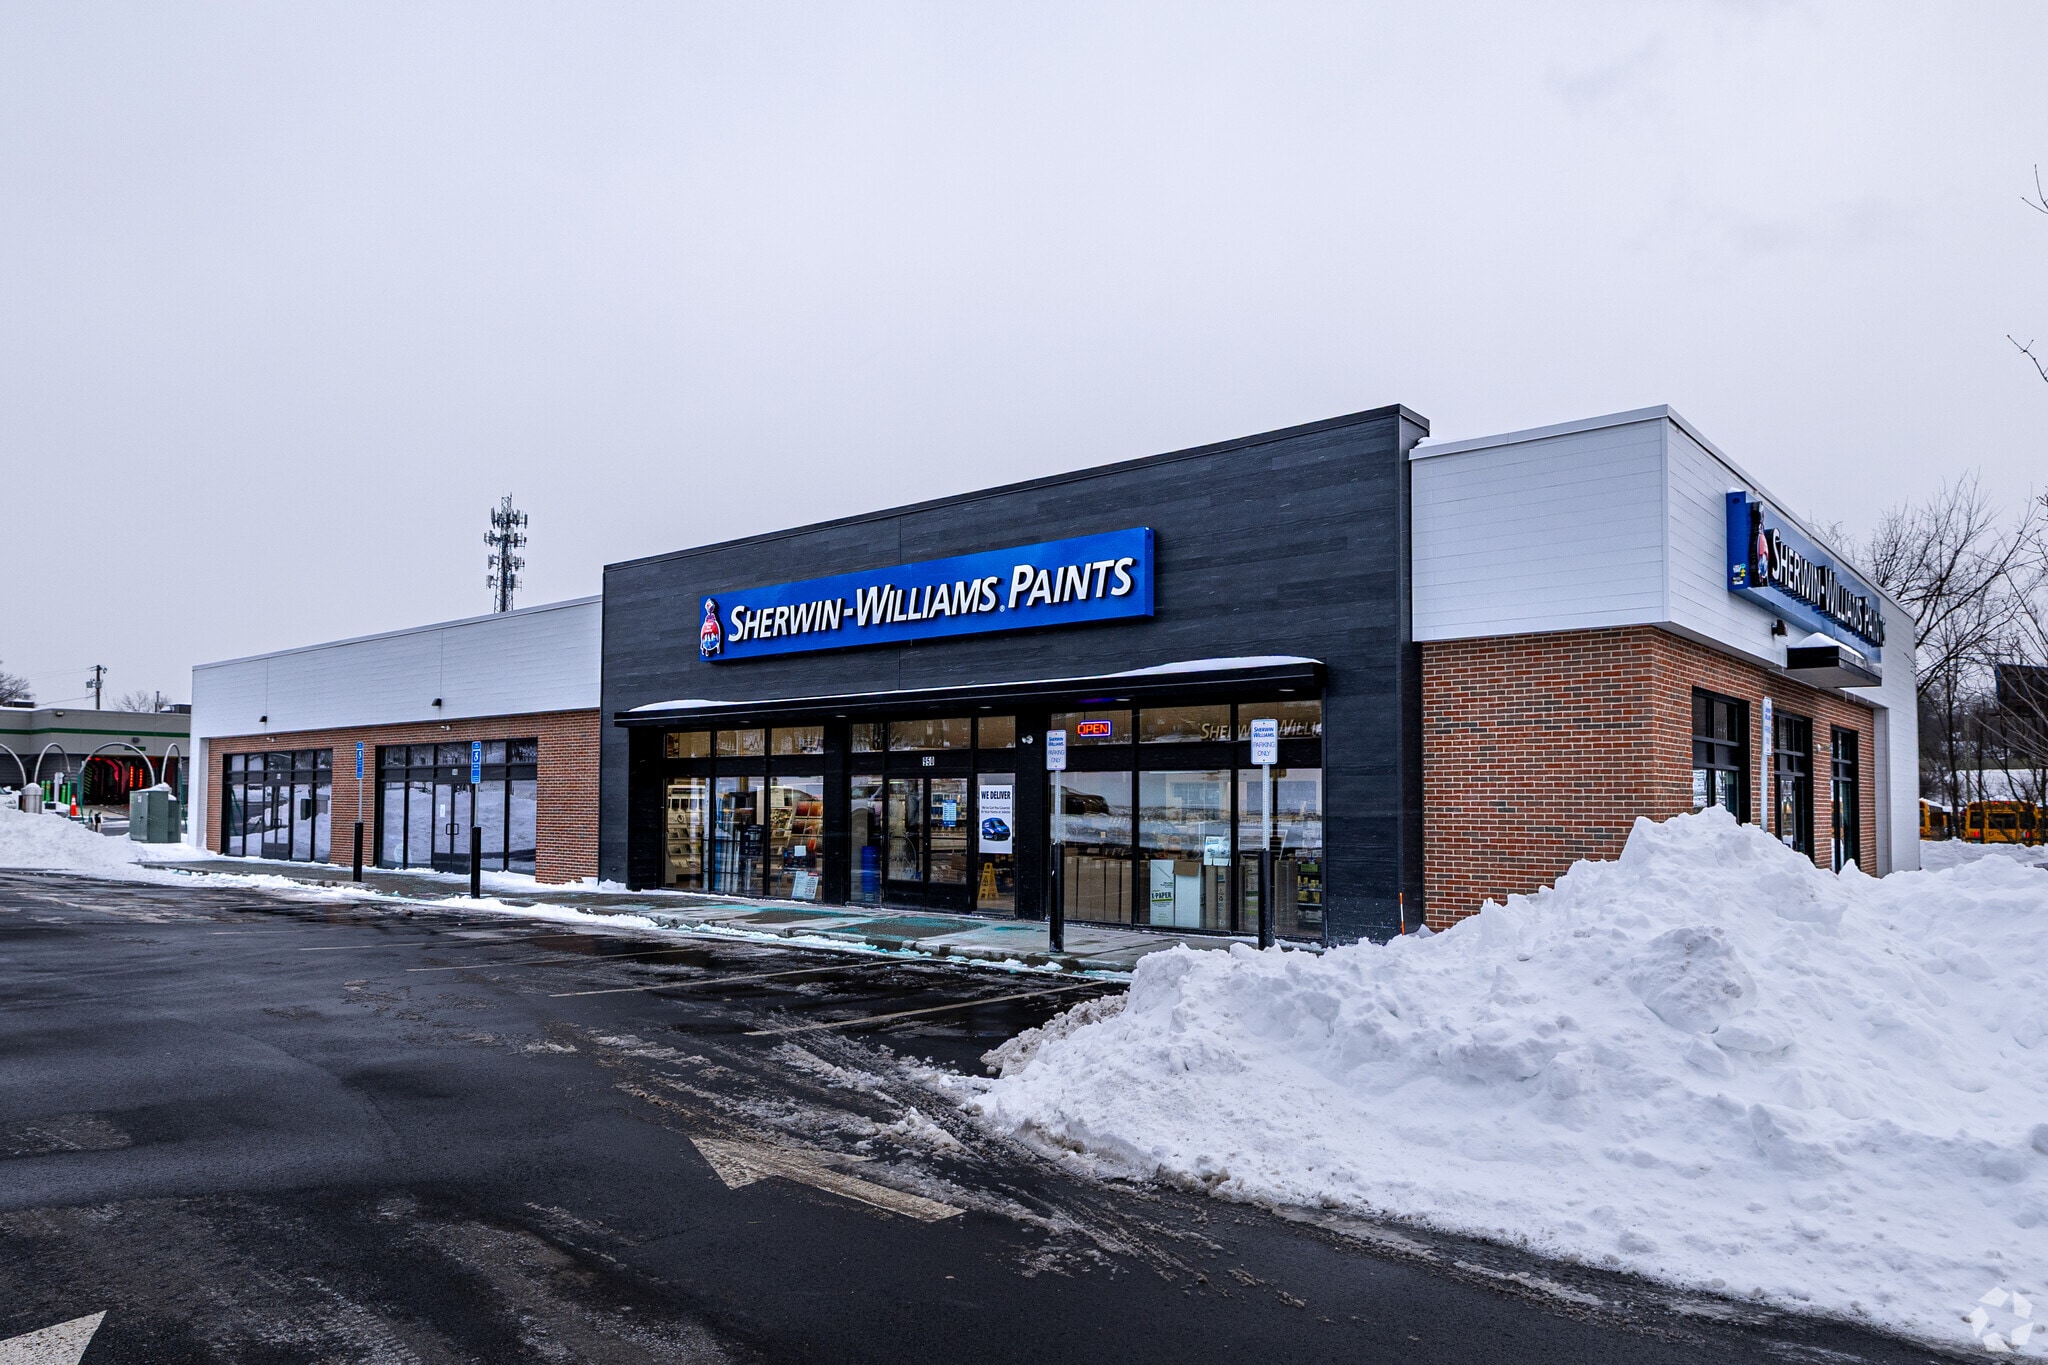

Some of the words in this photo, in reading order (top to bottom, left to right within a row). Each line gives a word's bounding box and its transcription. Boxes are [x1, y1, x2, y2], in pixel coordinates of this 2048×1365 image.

[1008, 557, 1135, 609] PAINTS
[1077, 723, 1108, 735] OPEN
[981, 791, 989, 800] WE
[990, 791, 1011, 800] DELIVER
